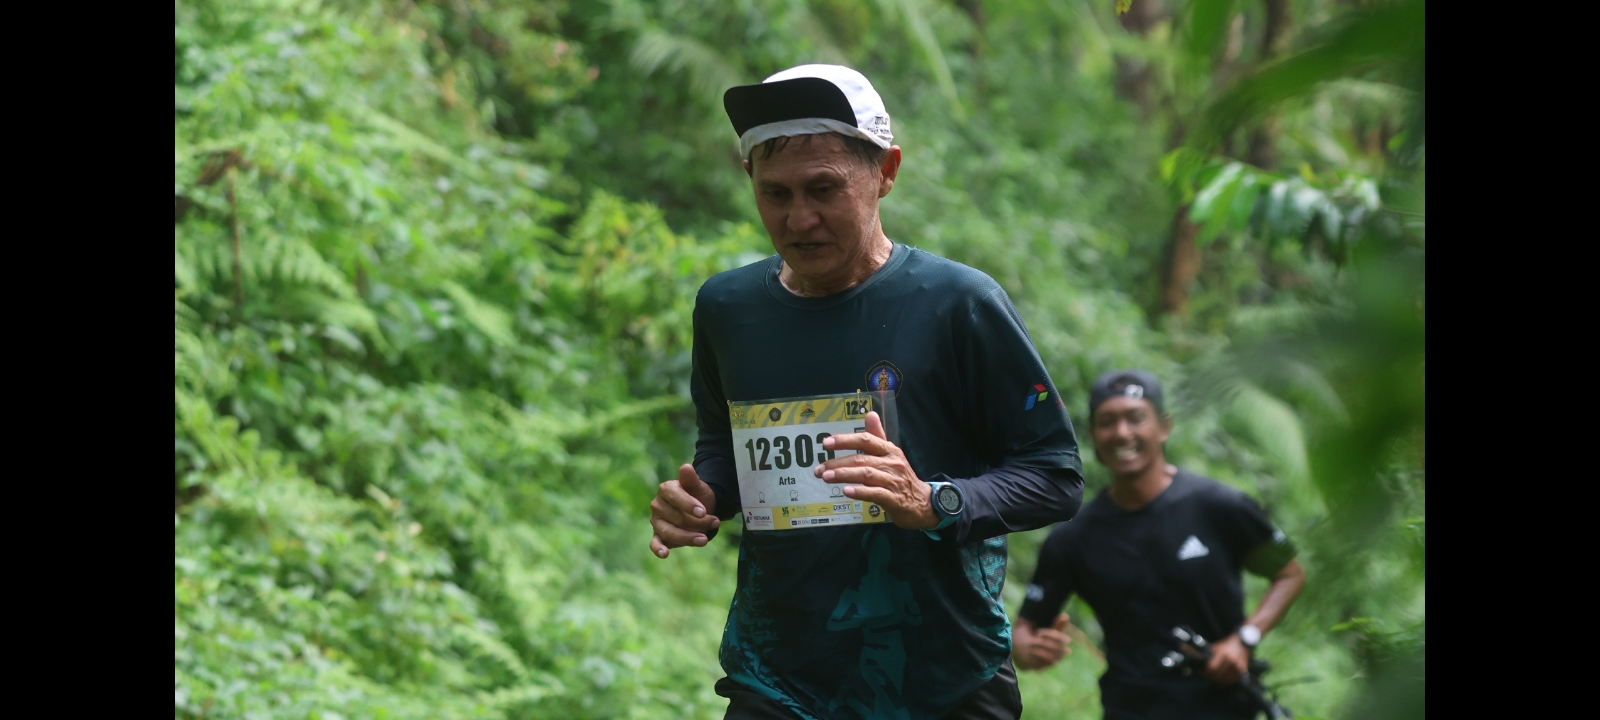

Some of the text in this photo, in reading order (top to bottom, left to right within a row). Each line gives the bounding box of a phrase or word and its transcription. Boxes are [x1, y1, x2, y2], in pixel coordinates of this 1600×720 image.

[845, 400, 869, 415] 12K
[745, 432, 835, 471] 12303
[779, 476, 796, 485] Arta
